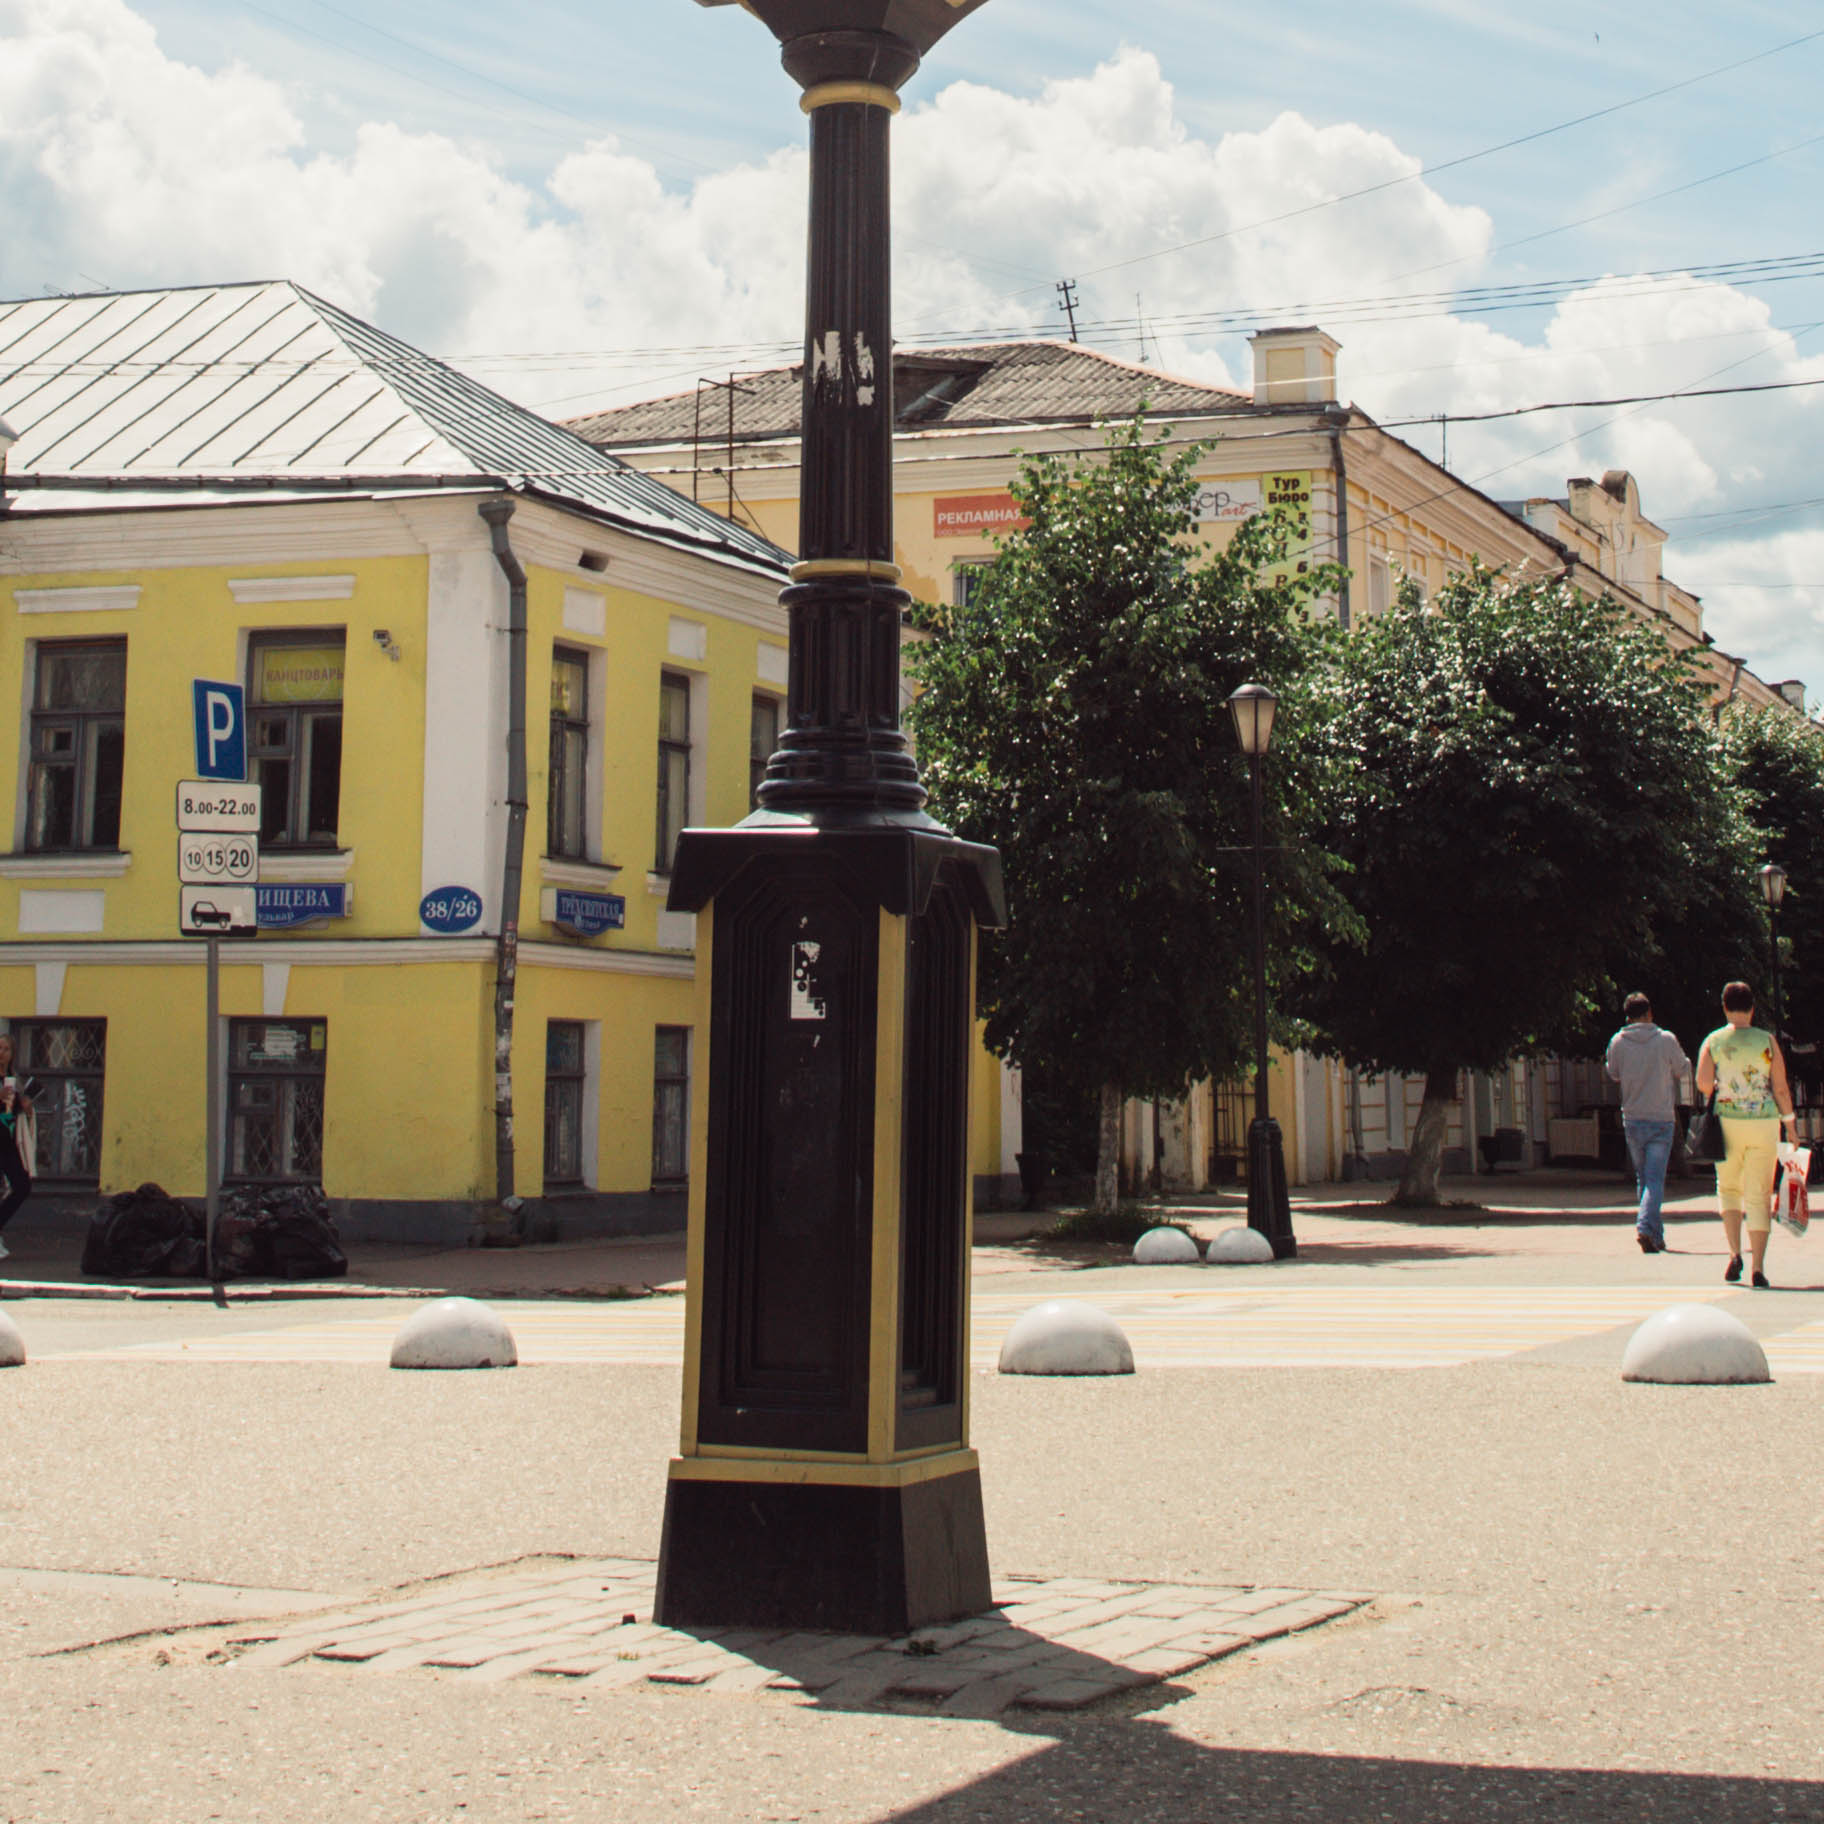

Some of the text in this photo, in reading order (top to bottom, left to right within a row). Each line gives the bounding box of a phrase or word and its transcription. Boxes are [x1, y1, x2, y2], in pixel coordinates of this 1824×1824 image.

[1273, 477, 1300, 492] Тур
[1268, 491, 1309, 505] Бюро
[206, 690, 234, 767] P
[184, 797, 256, 817] 8.00-22.00
[187, 850, 249, 868] 10 15 20
[258, 887, 330, 908] ИЩЕВА
[258, 911, 295, 924] ульвар
[425, 896, 478, 921] 38/26
